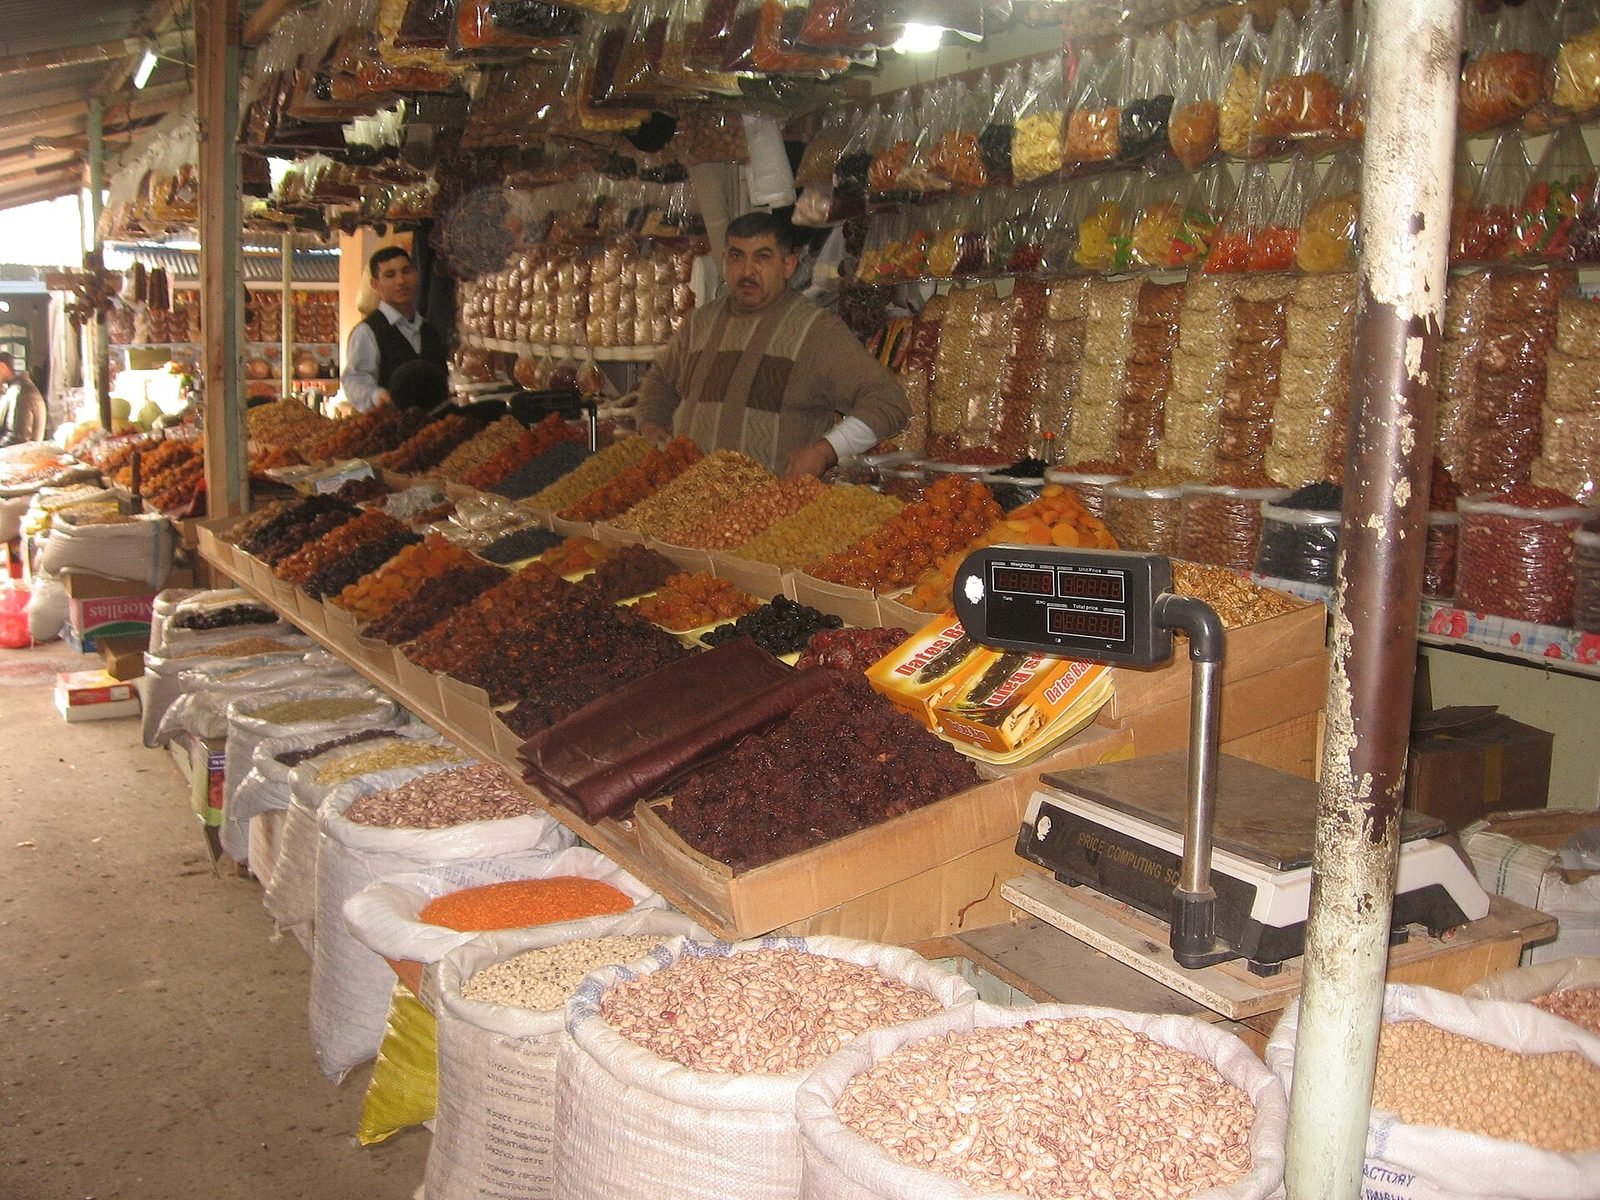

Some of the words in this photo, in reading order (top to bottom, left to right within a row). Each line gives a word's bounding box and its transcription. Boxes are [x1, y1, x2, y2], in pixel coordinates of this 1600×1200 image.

[894, 638, 952, 677] Dates
[1044, 672, 1076, 704] Dates
[1077, 831, 1105, 855] PRICE
[1107, 844, 1162, 879] COMPUTING
